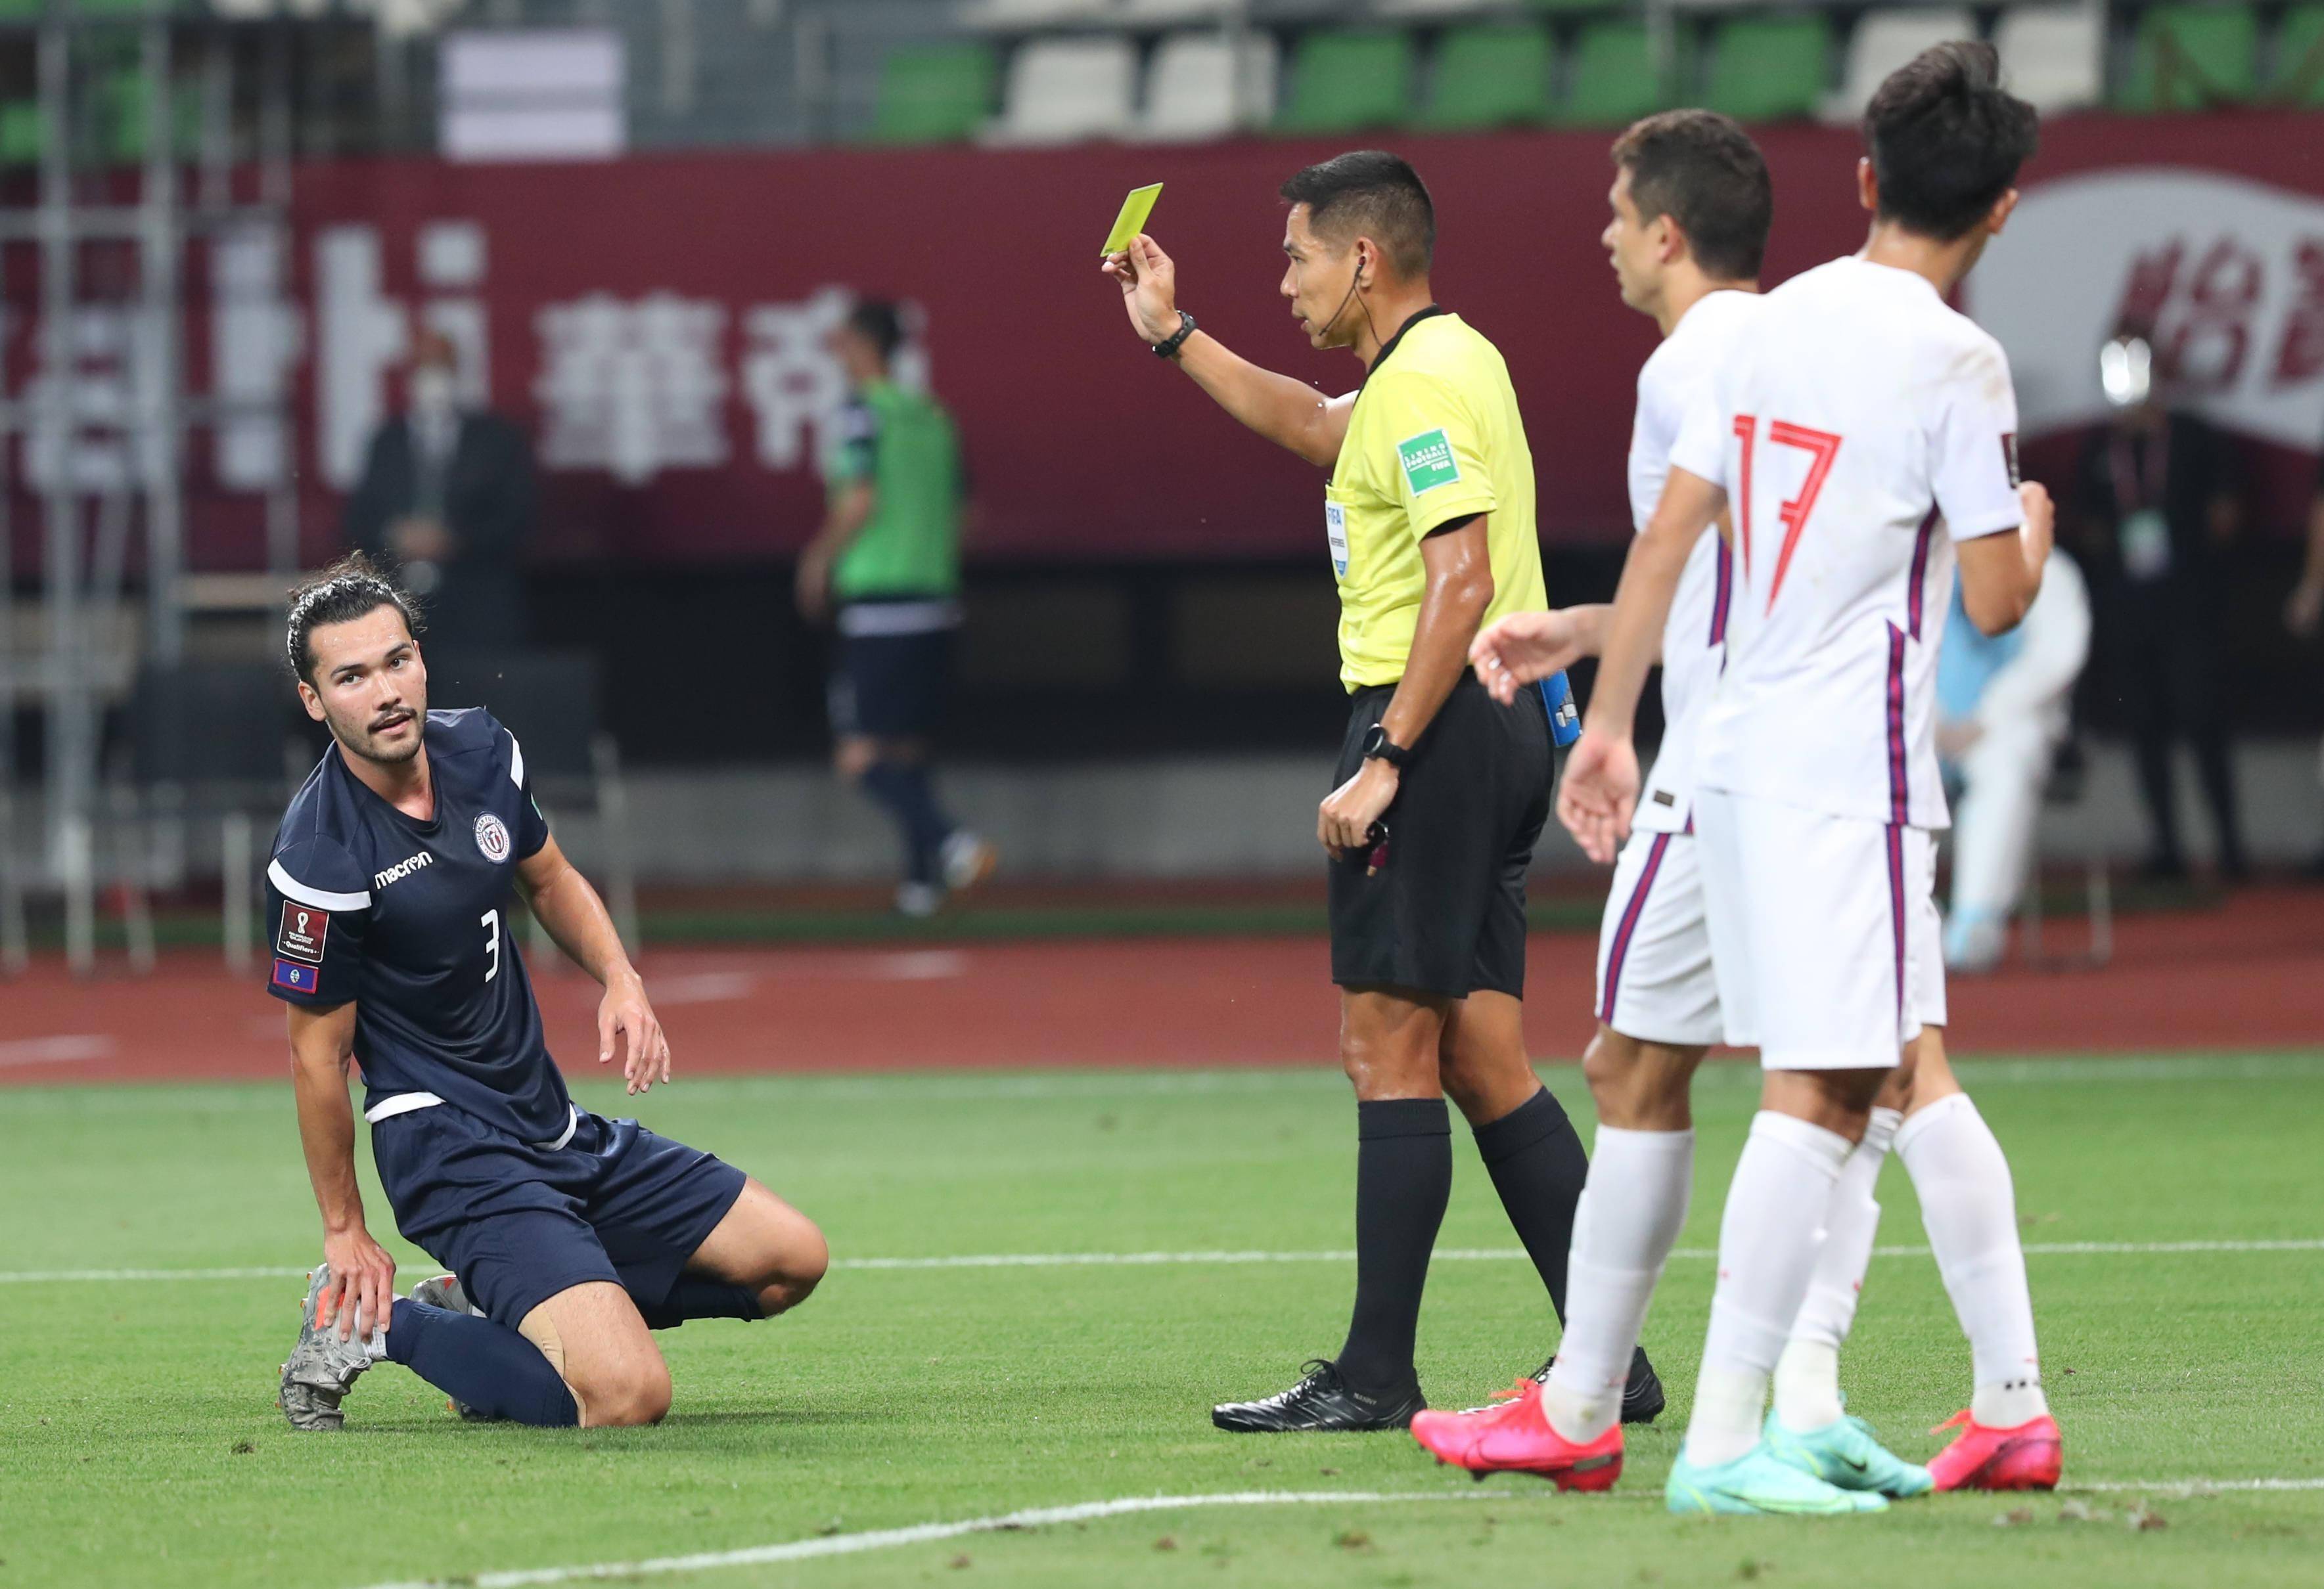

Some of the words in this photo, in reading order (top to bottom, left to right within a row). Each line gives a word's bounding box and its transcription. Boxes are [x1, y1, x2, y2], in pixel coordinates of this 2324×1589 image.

[1430, 460, 1451, 472] FIFA
[1733, 414, 1844, 619] 17
[375, 851, 434, 890] macron
[285, 941, 314, 954] Qualifiers
[480, 908, 499, 983] 3
